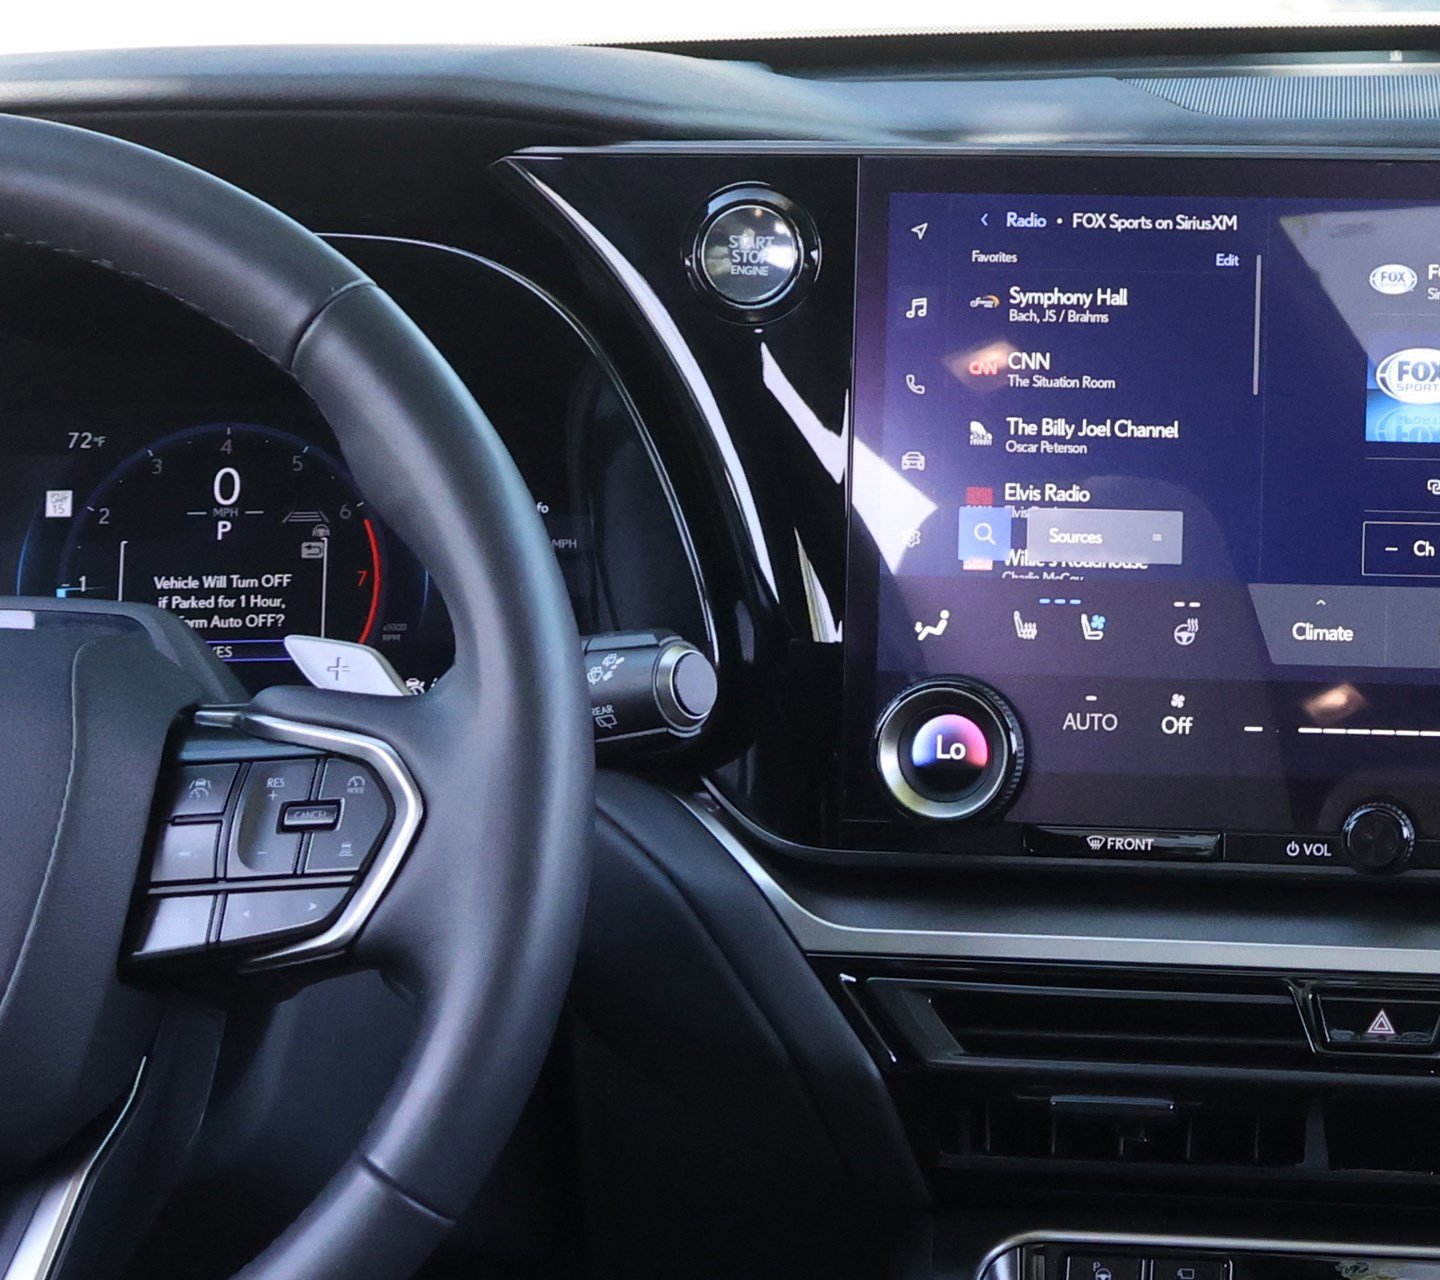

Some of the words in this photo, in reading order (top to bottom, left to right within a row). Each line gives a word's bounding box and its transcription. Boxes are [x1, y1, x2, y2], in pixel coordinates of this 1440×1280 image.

[1006, 212, 1047, 229] Radio
[1072, 213, 1107, 230] FOX
[1109, 214, 1152, 233] Sports
[1155, 218, 1173, 231] on
[1175, 214, 1238, 231] SiriusXM
[971, 250, 1018, 264] Favorites
[1216, 253, 1240, 267] Edit
[731, 265, 769, 276] ENGINE
[1380, 271, 1406, 283] FOX
[1009, 286, 1093, 308] Symphony
[1096, 288, 1128, 306] Hall
[1009, 309, 1040, 324] Bach,
[1043, 310, 1057, 322] JS
[1068, 310, 1109, 323] Brahms
[1007, 353, 1050, 371] CNN
[1007, 375, 1029, 388] The
[1031, 375, 1078, 389] Situation
[1082, 376, 1116, 390] Room
[1006, 417, 1037, 436] The
[1041, 418, 1075, 439] Billy
[1078, 419, 1110, 437] Joel
[1114, 420, 1179, 439] Channel
[220, 439, 232, 455] 4
[1005, 440, 1038, 453] Oscar
[1041, 441, 1088, 455] Peterson
[152, 459, 162, 475] 3
[292, 456, 303, 471] 5
[213, 467, 241, 506] 0
[1004, 482, 1041, 502] Elvis
[1045, 483, 1091, 503] Radio
[99, 508, 110, 525] 2
[213, 508, 239, 517] MPH
[339, 504, 351, 519] 6
[216, 521, 232, 540] P
[1049, 527, 1103, 544] Sources
[1413, 541, 1435, 559] Ch
[78, 575, 87, 592] 1
[153, 575, 199, 589] Vehicle
[202, 575, 227, 589] Will
[230, 575, 258, 588] Turn
[261, 574, 292, 588] OFF
[357, 570, 368, 586] 7
[171, 596, 215, 609] Parked
[217, 595, 236, 608] for
[250, 595, 286, 610] Hour,
[210, 615, 242, 628] Auto
[245, 613, 286, 628] OFF?
[1292, 622, 1353, 642] Climate
[1062, 713, 1118, 732] AUTO
[1161, 715, 1193, 736] Off
[936, 735, 966, 761] Lo
[267, 777, 285, 788] RES
[1107, 837, 1155, 852] FRONT
[1303, 843, 1332, 858] VOL
